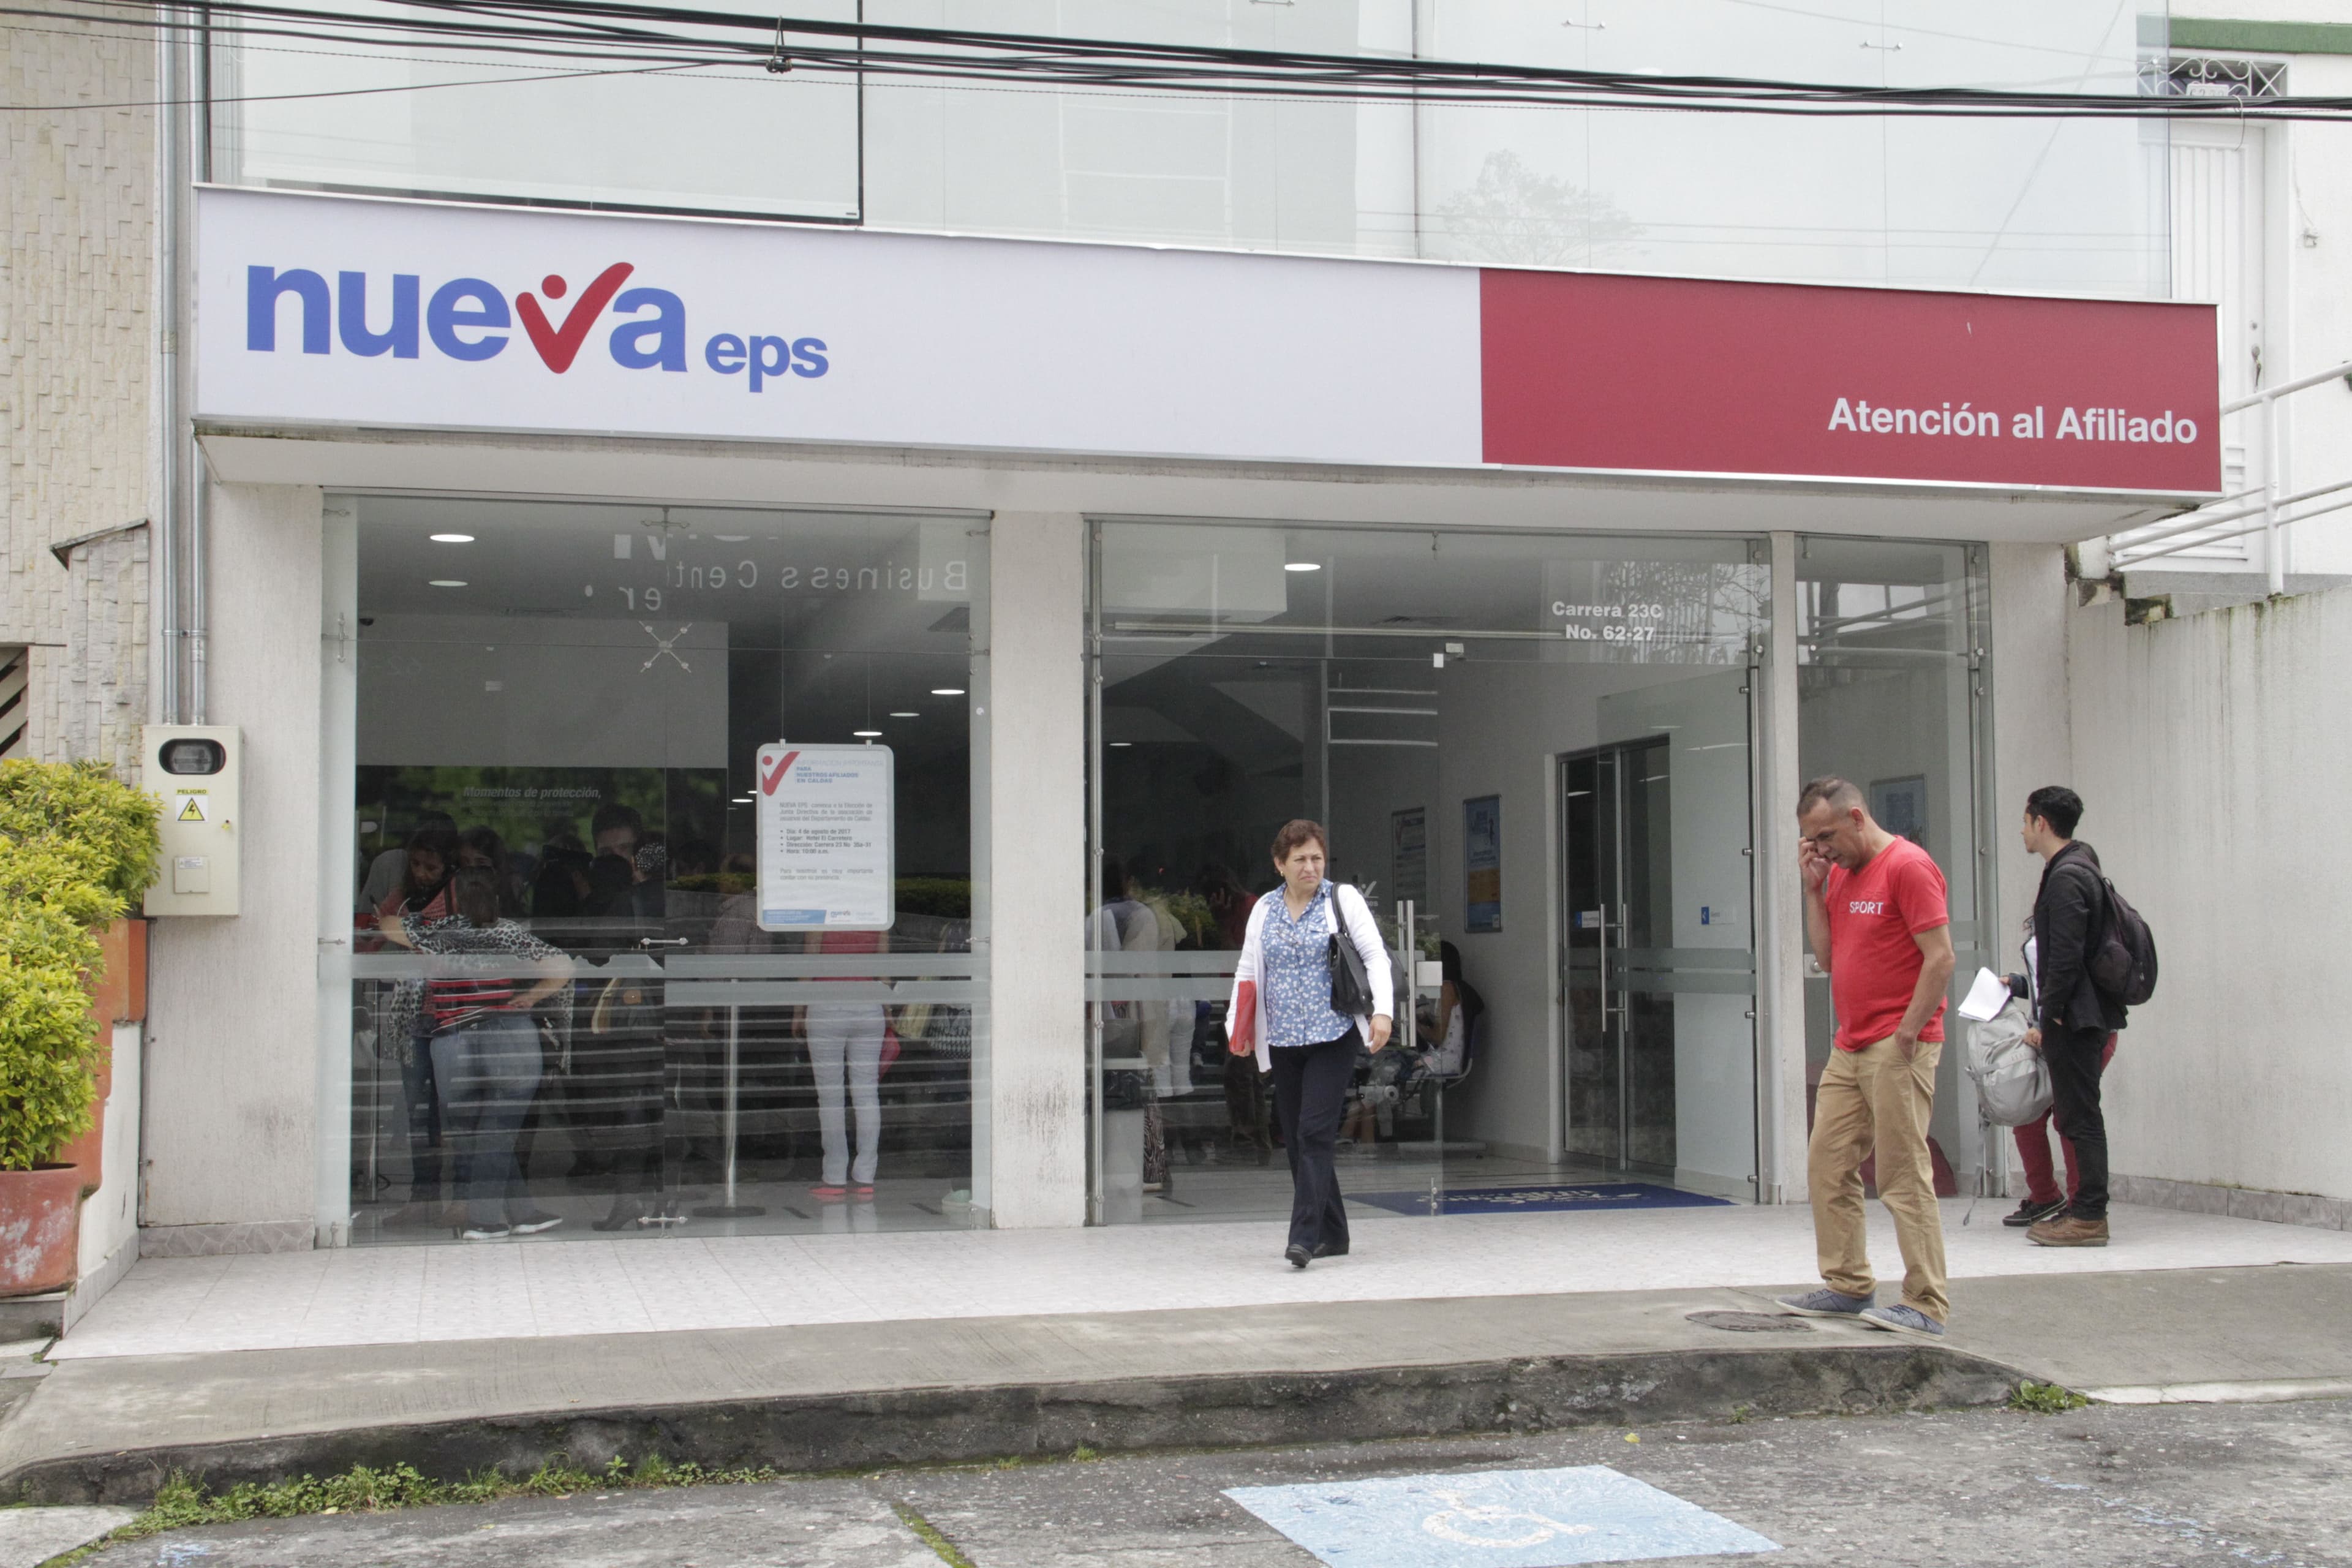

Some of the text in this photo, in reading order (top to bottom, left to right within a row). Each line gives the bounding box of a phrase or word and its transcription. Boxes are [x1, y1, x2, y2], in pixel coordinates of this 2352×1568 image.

[246, 262, 829, 393] nueva eps
[1828, 398, 2197, 444] Atención al Afiliado
[1552, 601, 1662, 618] Carrera 23C
[1566, 624, 1654, 641] No. 62-27
[464, 786, 601, 799] Momentos de protección,
[1850, 901, 1883, 914] SPORT
